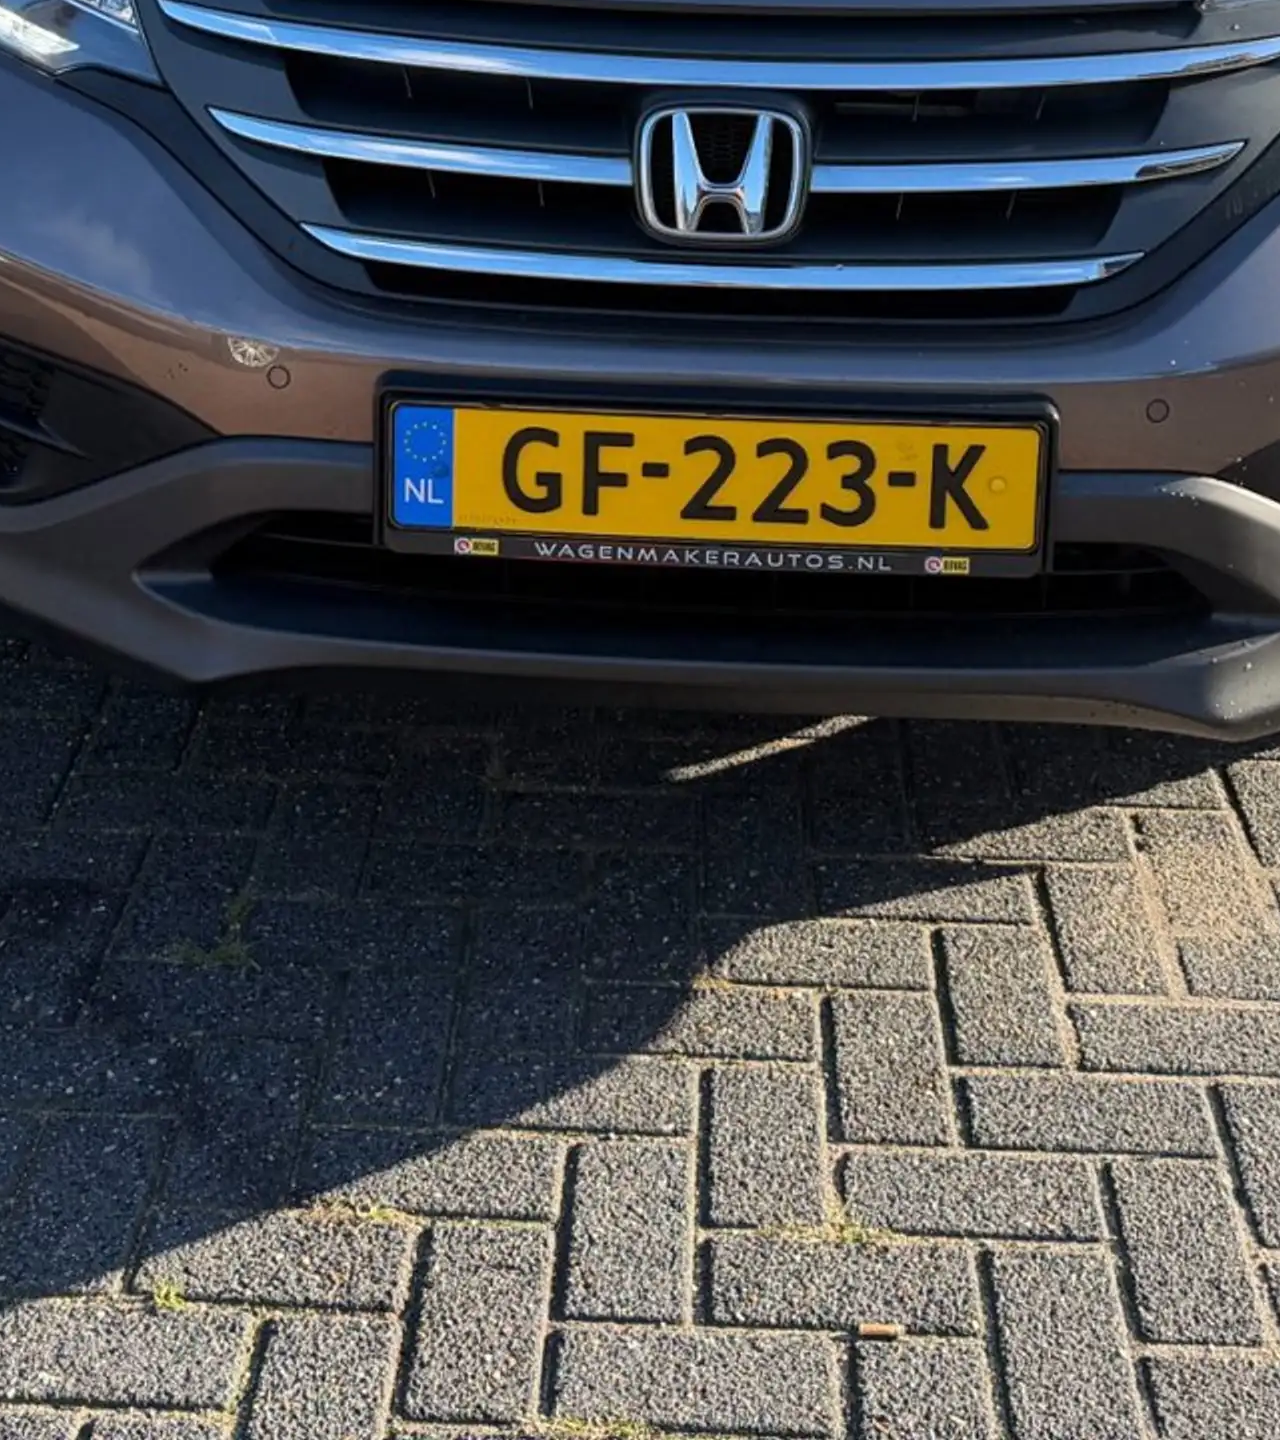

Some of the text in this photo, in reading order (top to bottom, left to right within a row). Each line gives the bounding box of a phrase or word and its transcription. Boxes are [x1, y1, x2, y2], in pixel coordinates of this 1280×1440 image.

[403, 478, 445, 505] NL
[500, 425, 990, 533] GF-223-K
[533, 541, 894, 572] WAGENMAKERAUTOS.NL
